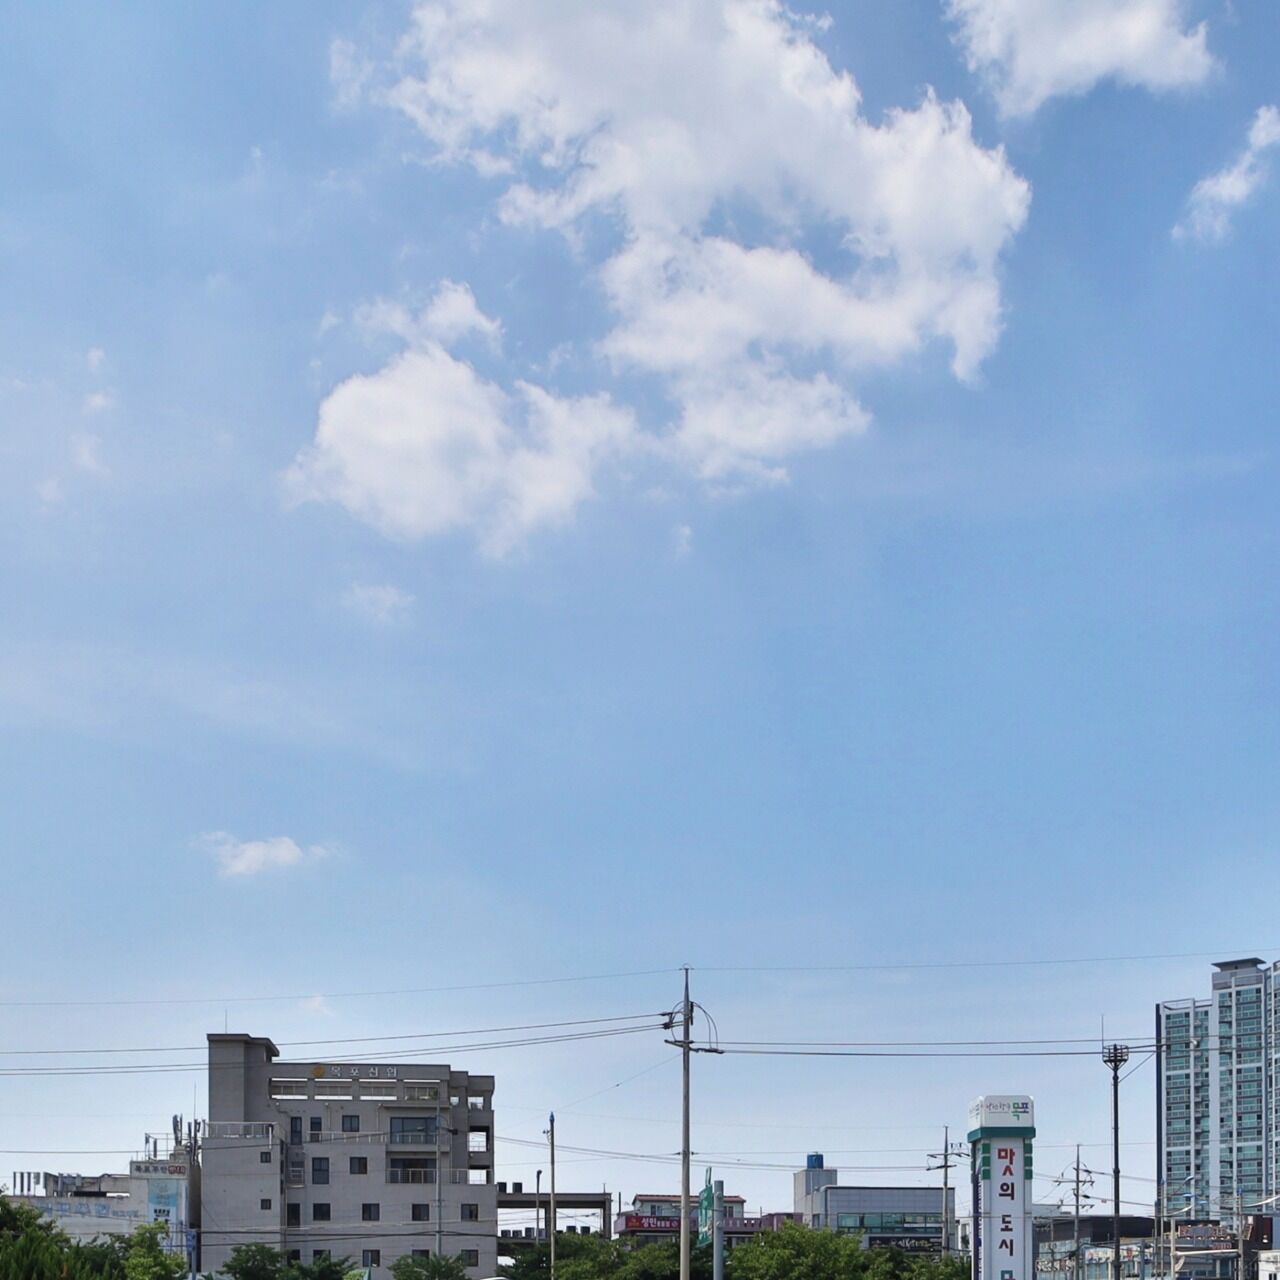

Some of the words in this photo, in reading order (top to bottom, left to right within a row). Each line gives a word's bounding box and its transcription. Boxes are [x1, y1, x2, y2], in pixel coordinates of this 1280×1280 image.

[331, 1066, 397, 1078] 목포신협
[1011, 1102, 1029, 1121] 목포
[997, 1148, 1015, 1201] 맛의
[998, 1214, 1014, 1257] 도시
